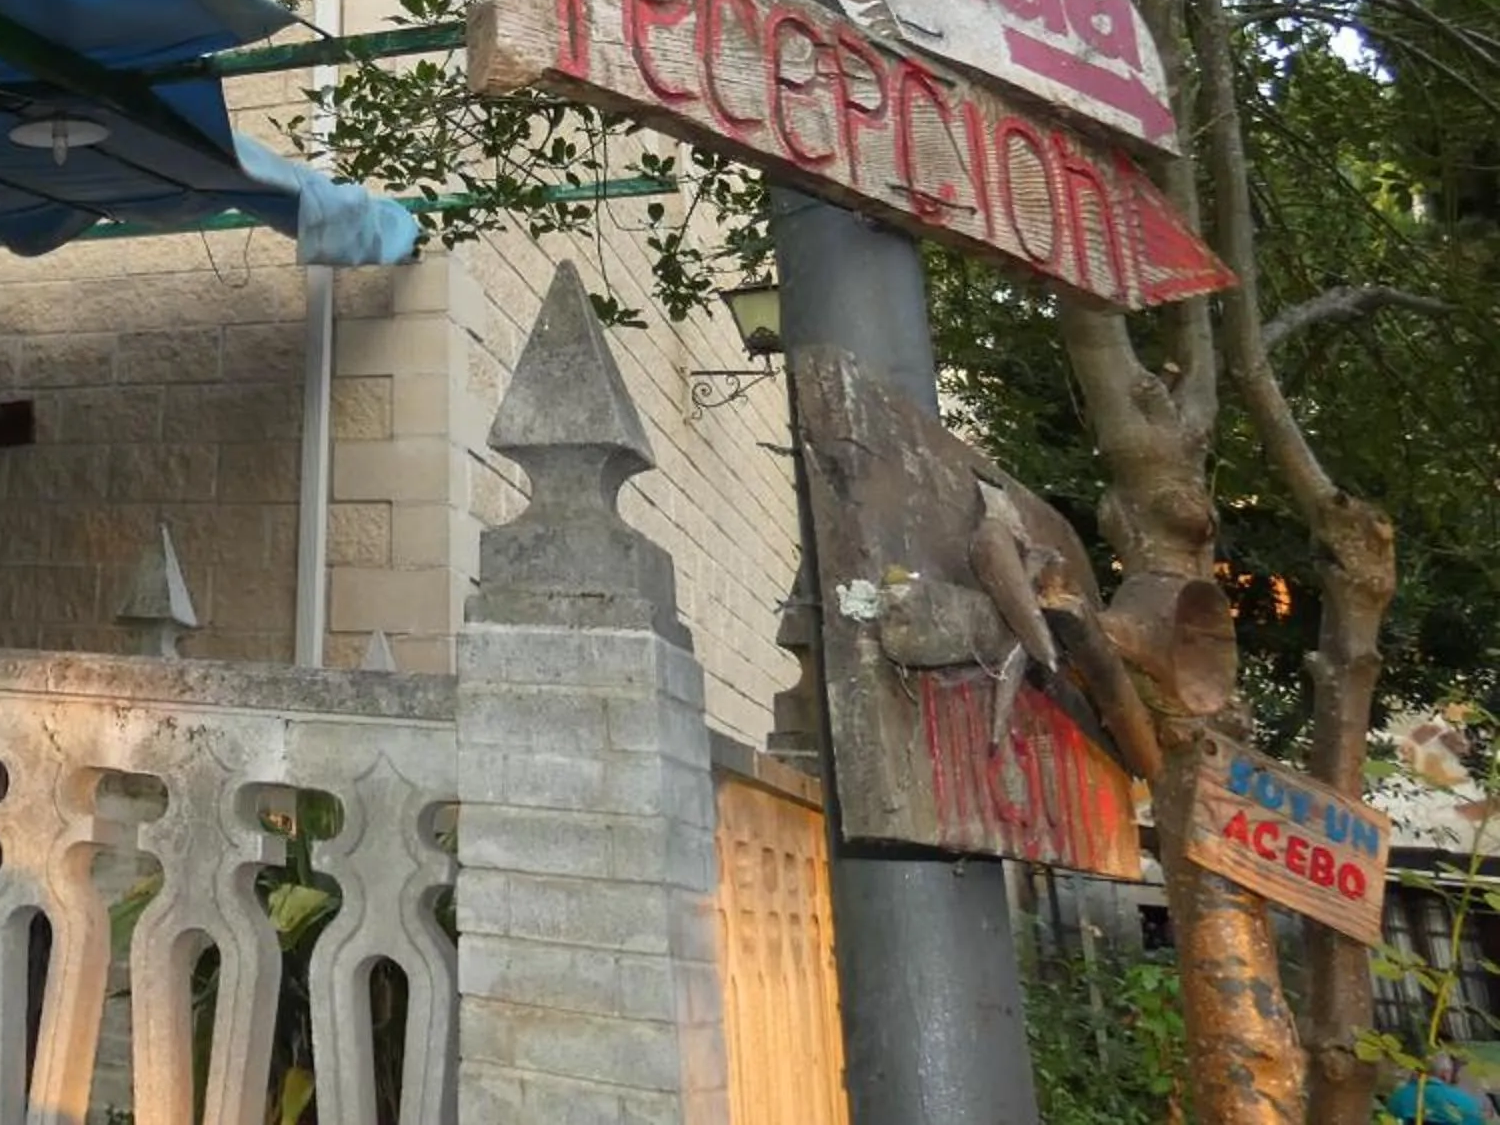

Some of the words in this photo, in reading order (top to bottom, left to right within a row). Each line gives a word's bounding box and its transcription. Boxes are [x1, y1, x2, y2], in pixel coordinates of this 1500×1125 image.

[1222, 809, 1367, 901] ACEBO
[1227, 755, 1313, 826] SOY
[1324, 802, 1380, 859] UN
